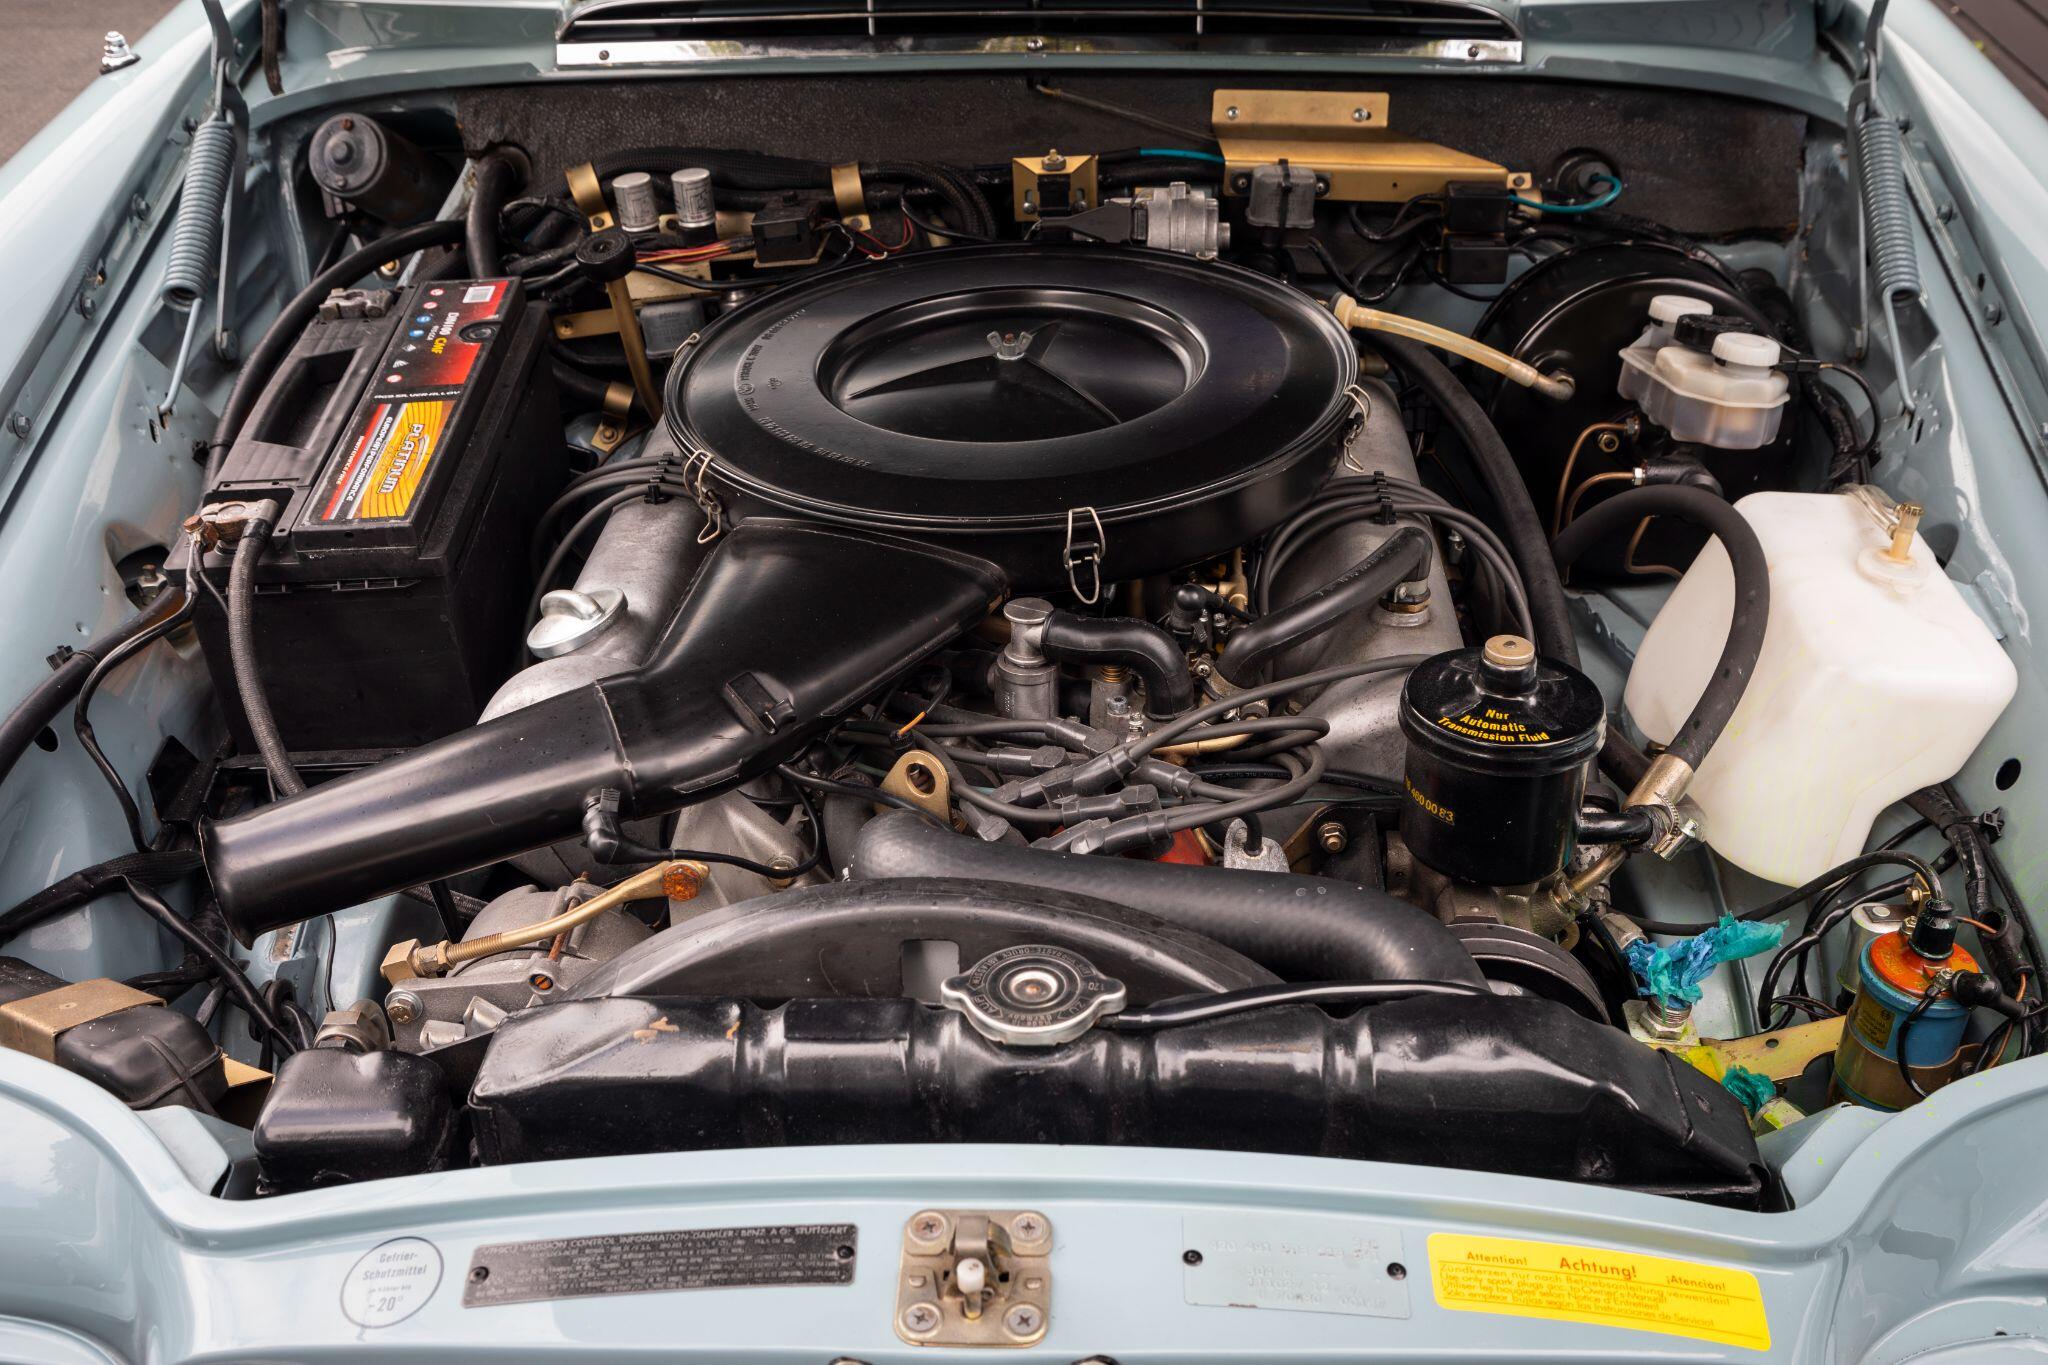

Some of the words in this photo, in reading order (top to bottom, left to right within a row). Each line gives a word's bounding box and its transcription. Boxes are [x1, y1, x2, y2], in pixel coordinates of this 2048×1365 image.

[370, 416, 394, 452] EUROPEAN
[378, 423, 425, 494] PLATINUM
[345, 451, 376, 502] PERFORMANCE
[1459, 714, 1527, 732] Automatic
[1485, 708, 1510, 720] Nur
[1436, 716, 1516, 743] Transmission
[1518, 731, 1550, 743] Fluid
[1425, 799, 1438, 815] 00
[973, 995, 999, 1015] AUF
[570, 1237, 616, 1248] CONTROL
[619, 1232, 693, 1244] INFORMATION
[794, 1225, 848, 1236] STUTTGART
[378, 1250, 418, 1264] Gefrier-
[1466, 1251, 1528, 1266] Attention!
[362, 1264, 428, 1281] Schutzmittel
[1511, 1270, 1530, 1280] nur
[1559, 1256, 1637, 1281] Achtung!
